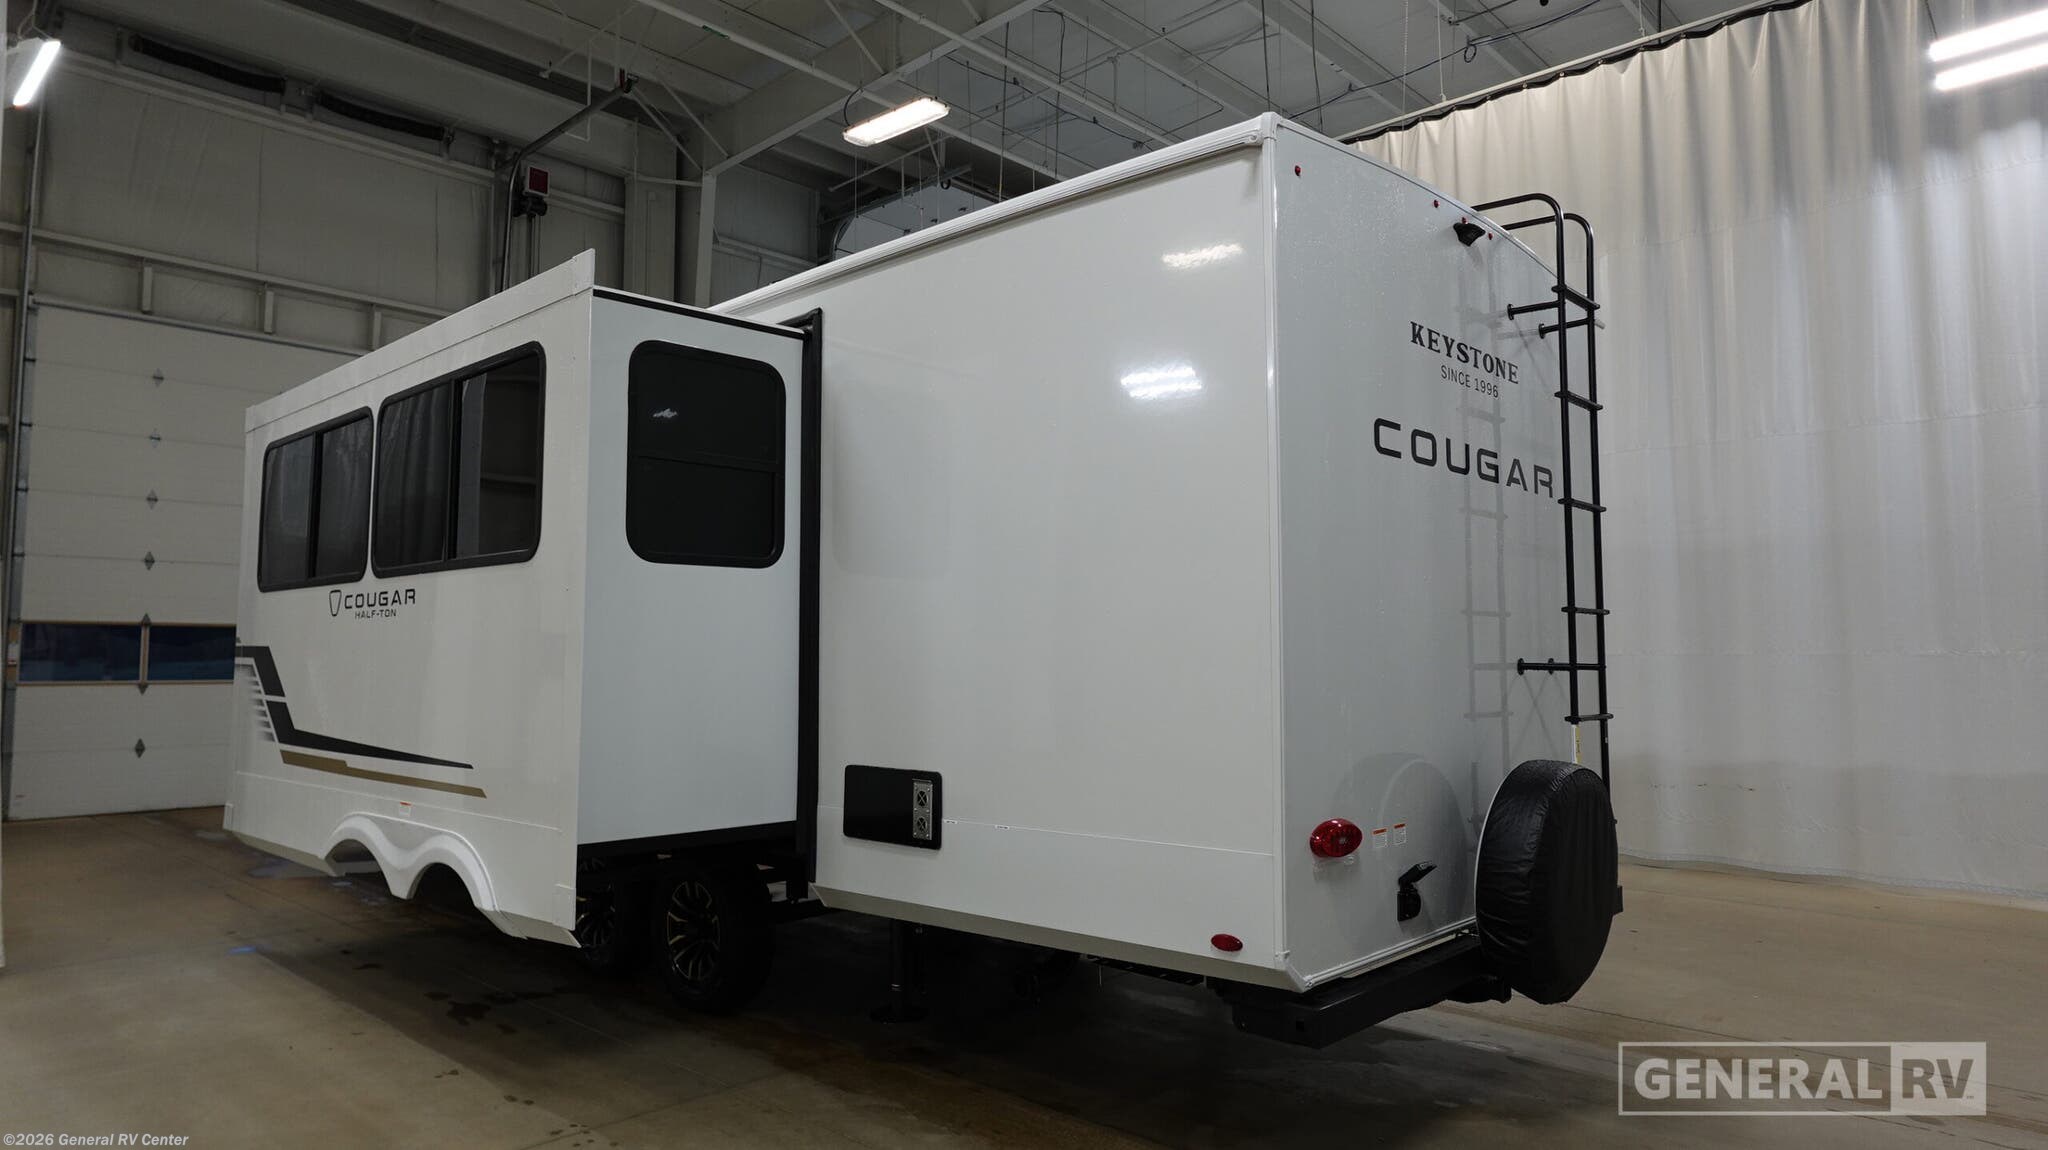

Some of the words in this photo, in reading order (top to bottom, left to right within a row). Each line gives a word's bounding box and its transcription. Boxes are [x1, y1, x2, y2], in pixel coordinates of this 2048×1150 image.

[1410, 321, 1519, 384] KEYSTONE
[1441, 365, 1471, 388] SINCE
[1475, 378, 1499, 398] 1996
[1374, 418, 1553, 498] COUGAR
[344, 588, 416, 609] COUGAR
[355, 609, 397, 619] HALF-TON
